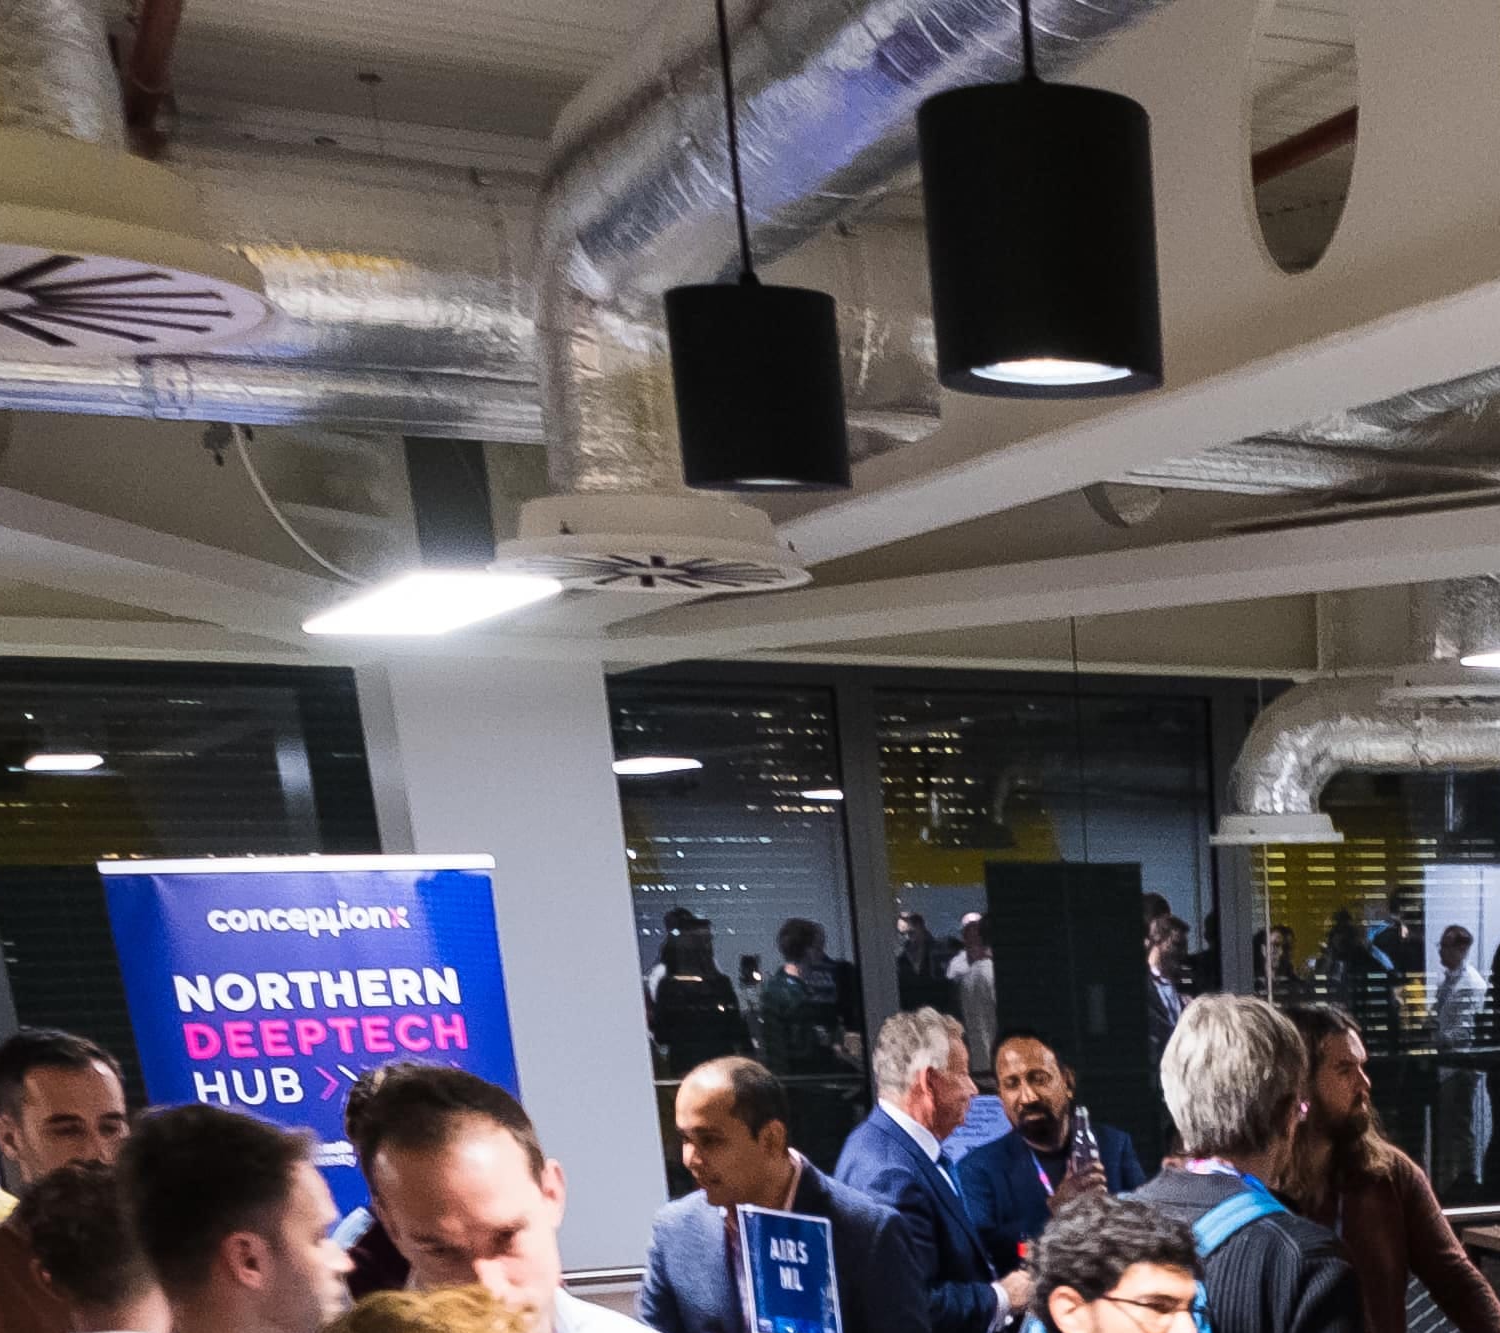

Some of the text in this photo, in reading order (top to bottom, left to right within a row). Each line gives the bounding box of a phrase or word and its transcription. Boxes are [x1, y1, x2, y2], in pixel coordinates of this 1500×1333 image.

[173, 968, 461, 1012] NORTHERN
[183, 1014, 468, 1060] DEEPTECH
[193, 1067, 304, 1105] HUB
[770, 1237, 809, 1265] AIRS
[779, 1265, 804, 1292] ML
